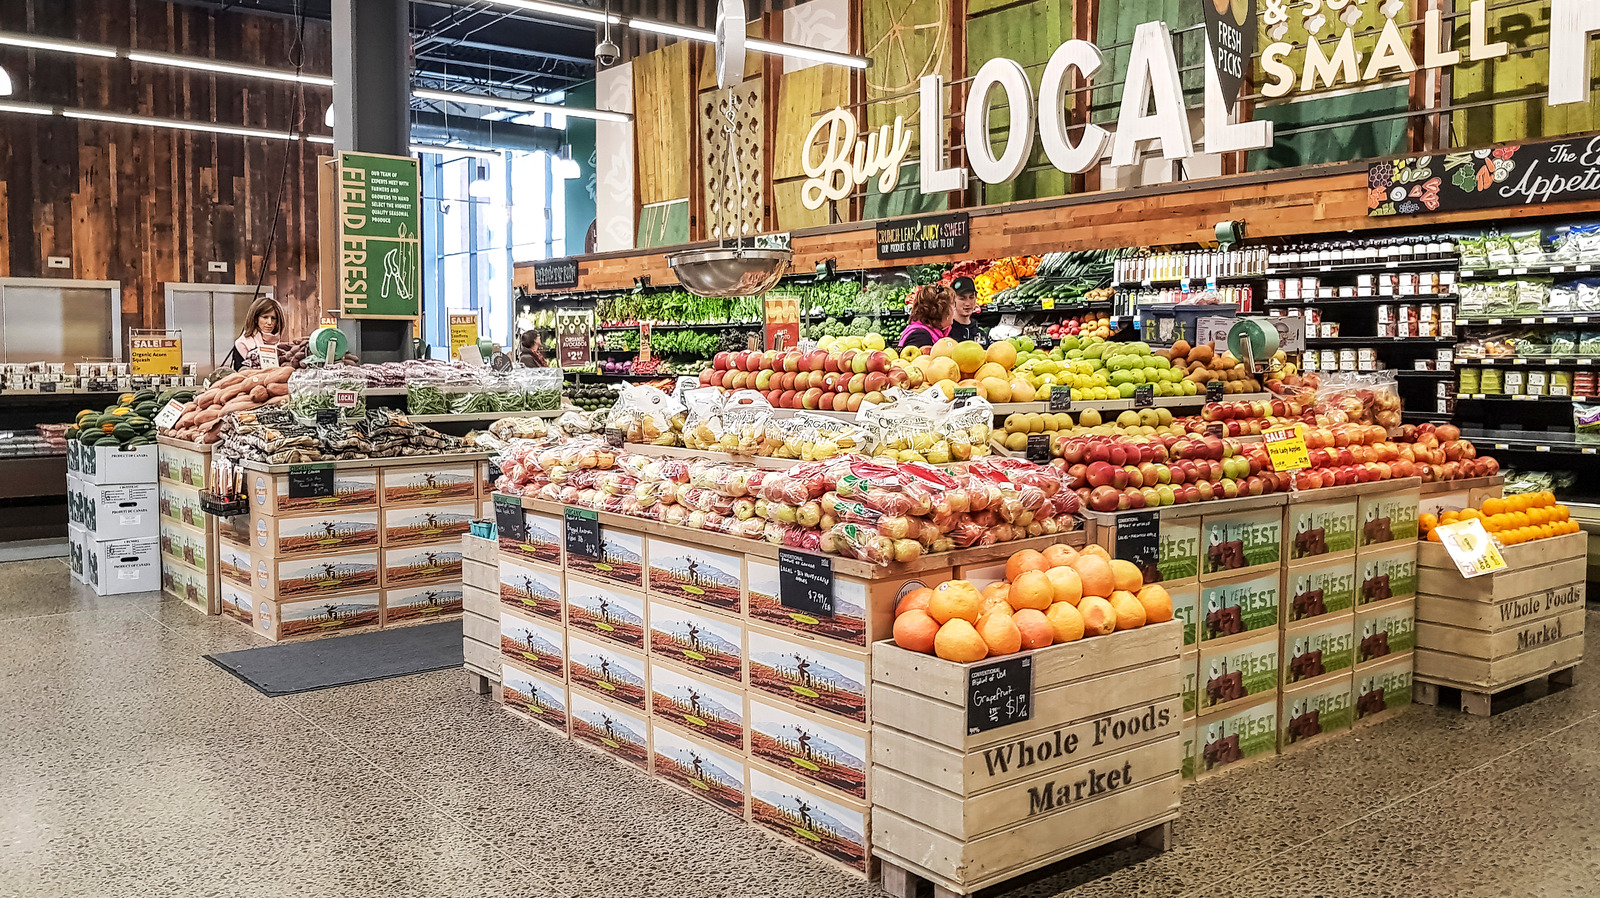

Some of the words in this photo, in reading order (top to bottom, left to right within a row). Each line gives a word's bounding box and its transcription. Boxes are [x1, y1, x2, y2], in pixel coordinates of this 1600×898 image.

[1217, 20, 1242, 48] FRESH
[1260, 0, 1510, 98] SMALL
[1217, 50, 1242, 79] PICKS
[801, 105, 914, 211] Buy
[919, 20, 1274, 195] LOCAL
[1548, 144, 1578, 163] The
[343, 167, 367, 230] FIELD
[389, 210, 409, 218] SEASONAL
[920, 223, 940, 241] JUICY
[944, 221, 966, 238] SWEET
[940, 238, 946, 248] TO
[344, 236, 368, 309] FRESH
[133, 340, 162, 348] SALE!
[338, 394, 354, 402] LOCAL
[1264, 430, 1287, 443] SALE!
[1323, 513, 1356, 534] BEST
[1390, 505, 1417, 523] BEST
[303, 532, 328, 540] FIELD
[331, 527, 357, 537] FRESH
[1243, 525, 1279, 546] BEST
[303, 573, 328, 582] FIELD
[331, 569, 356, 579] FRESH
[669, 567, 692, 581] FIELD
[692, 571, 719, 589] FRESH
[1388, 561, 1416, 579] BEST
[1322, 574, 1353, 595] BEST
[1239, 588, 1276, 611] BEST
[1499, 597, 1540, 622] Whole
[1544, 585, 1581, 611] Foods
[305, 614, 329, 623] FIELD
[332, 610, 358, 620] FRESH
[1386, 617, 1415, 636] BEST
[670, 631, 692, 646] FIELD
[693, 637, 719, 656] FRESH
[1320, 633, 1352, 654] BEST
[1516, 617, 1564, 650] Market
[1241, 652, 1277, 675] BEST
[773, 663, 801, 682] FIELD
[802, 670, 837, 694] FRESH
[1383, 671, 1413, 691] BEST
[672, 696, 693, 712] FIELD
[693, 702, 720, 722] FRESH
[1318, 691, 1350, 712] BEST
[1238, 715, 1276, 739] BEST
[774, 734, 801, 754] FIELD
[802, 744, 837, 768] FRESH
[983, 729, 1079, 777] Whole
[1091, 705, 1171, 747] Foods
[1027, 759, 1134, 817] Market
[775, 803, 802, 824] FIELD
[803, 814, 838, 839] FRESH
